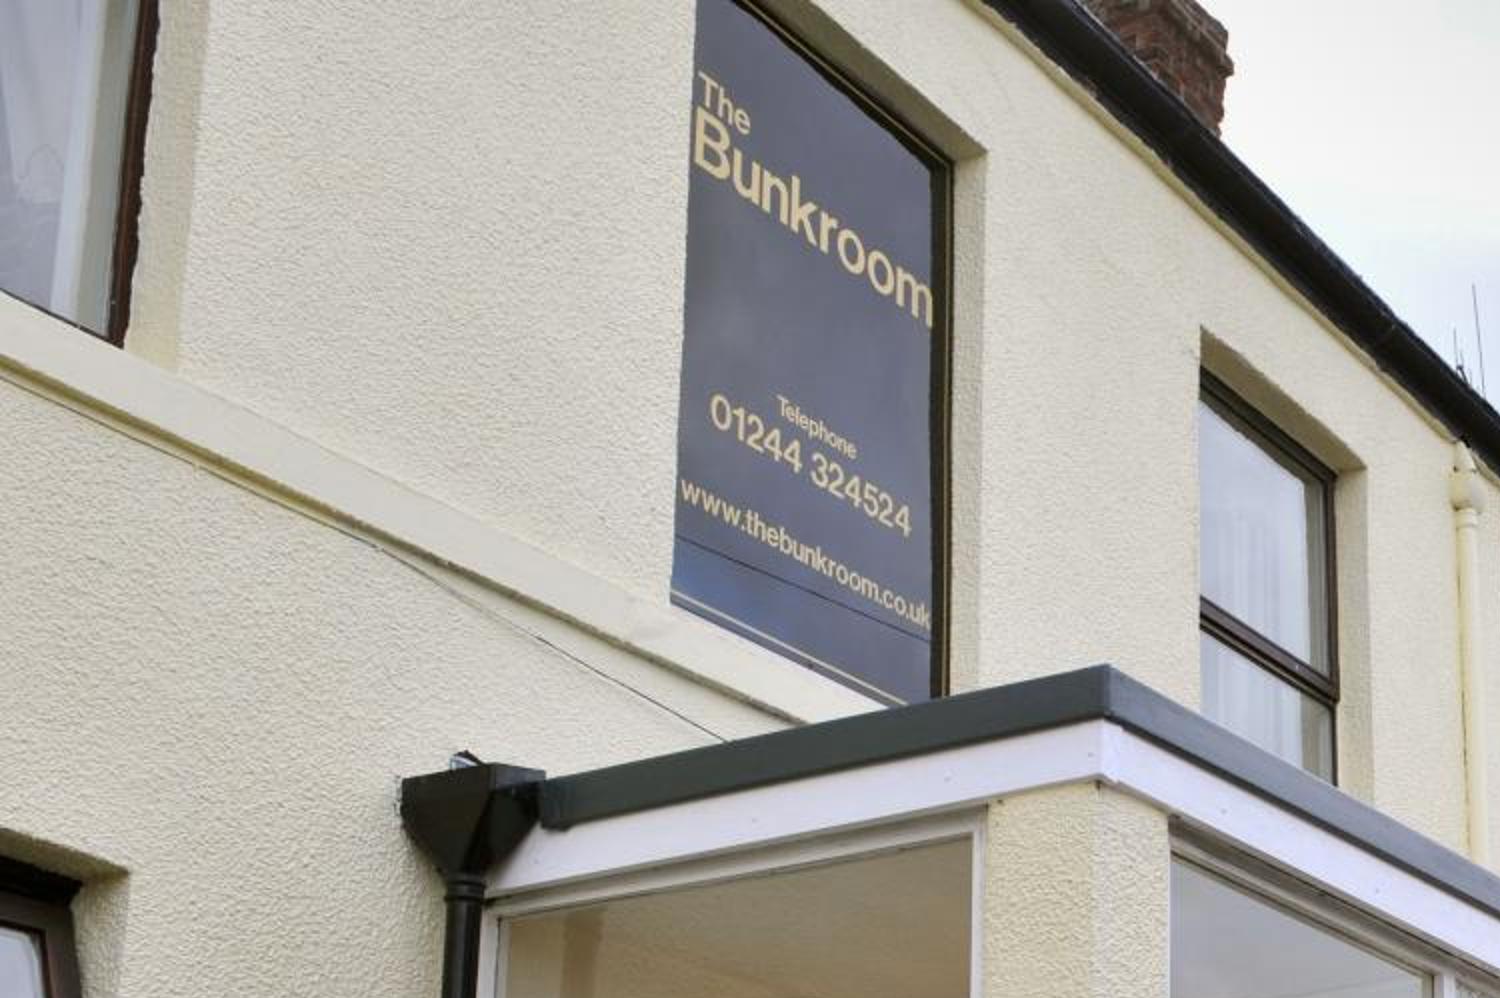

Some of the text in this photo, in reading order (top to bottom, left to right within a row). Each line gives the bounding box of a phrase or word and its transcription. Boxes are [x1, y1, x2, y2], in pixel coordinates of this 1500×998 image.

[699, 70, 750, 135] The
[694, 105, 933, 329] Bunkroom
[710, 394, 912, 536] 01244 324524
[777, 395, 857, 460] Telephone
[681, 479, 931, 630] www.thebunkroom.co.uk
